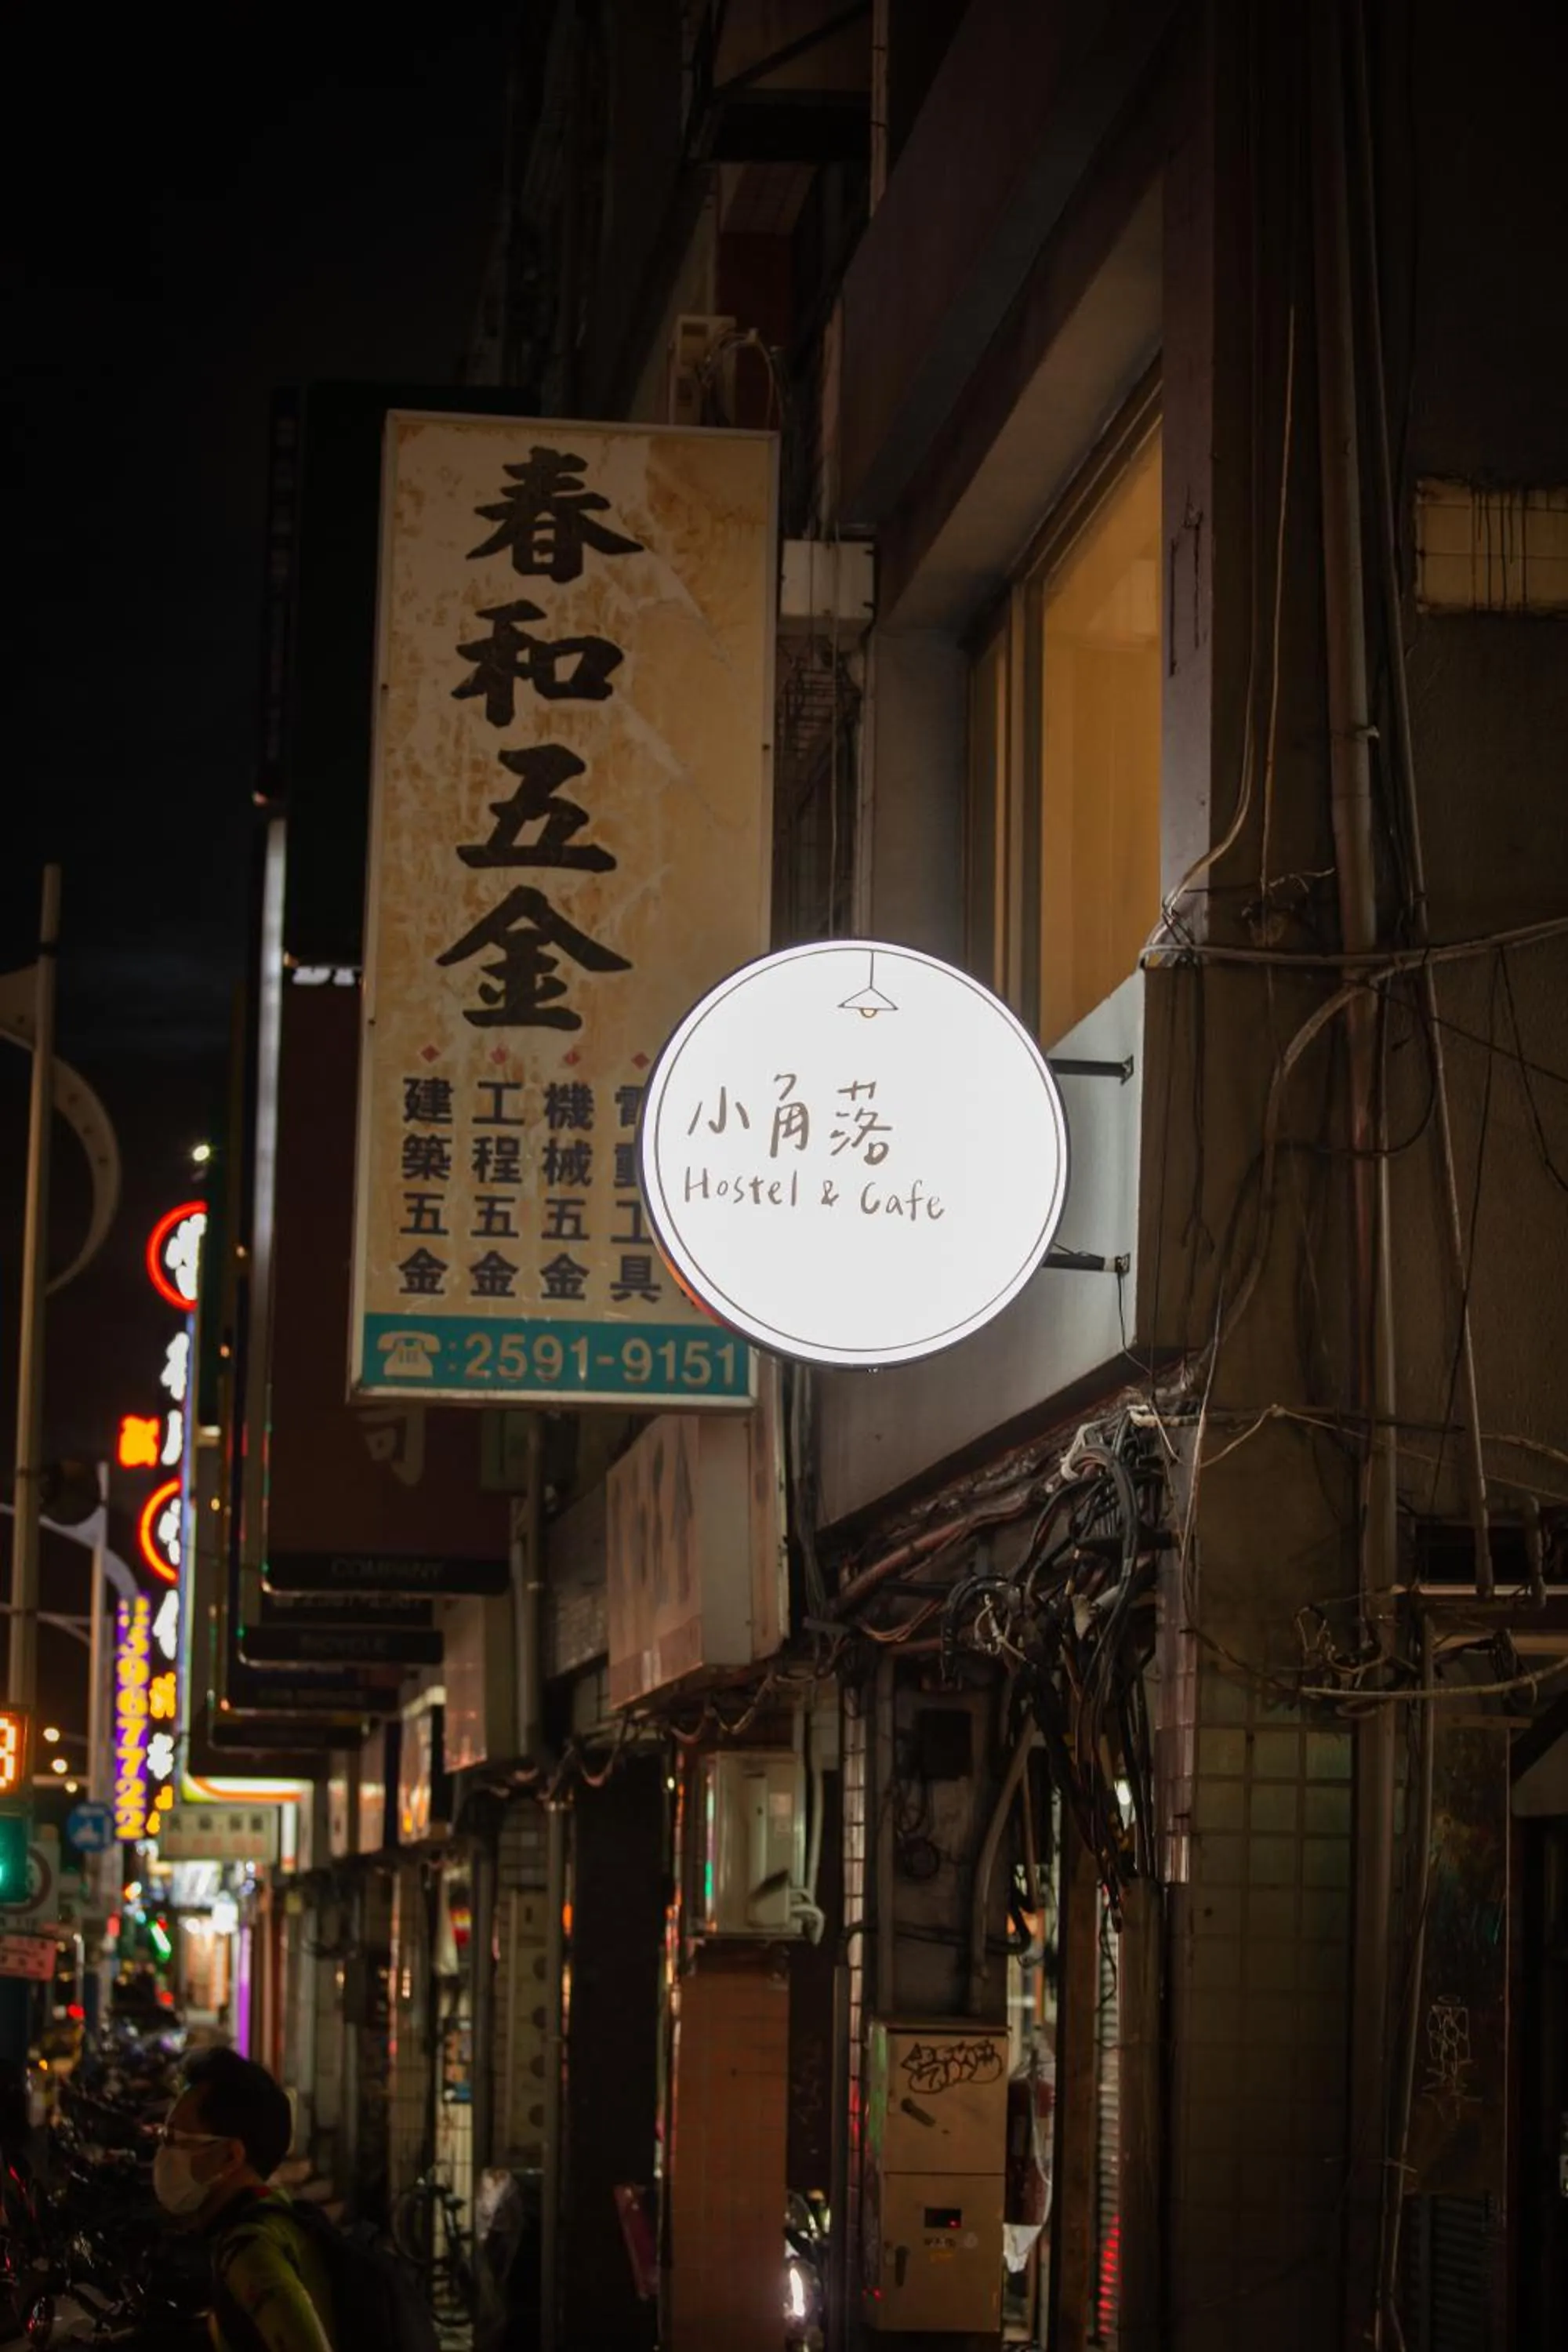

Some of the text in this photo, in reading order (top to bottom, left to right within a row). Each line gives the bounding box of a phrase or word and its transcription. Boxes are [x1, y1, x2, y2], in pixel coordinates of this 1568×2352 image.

[435, 445, 644, 1032] 春和五金
[398, 1077, 452, 1295] 建築五金
[470, 1080, 524, 1298] 工程五金
[539, 1082, 594, 1301] 機械五金
[684, 1166, 946, 1221] Hostel & Cafe
[687, 1073, 893, 1165] 小角落
